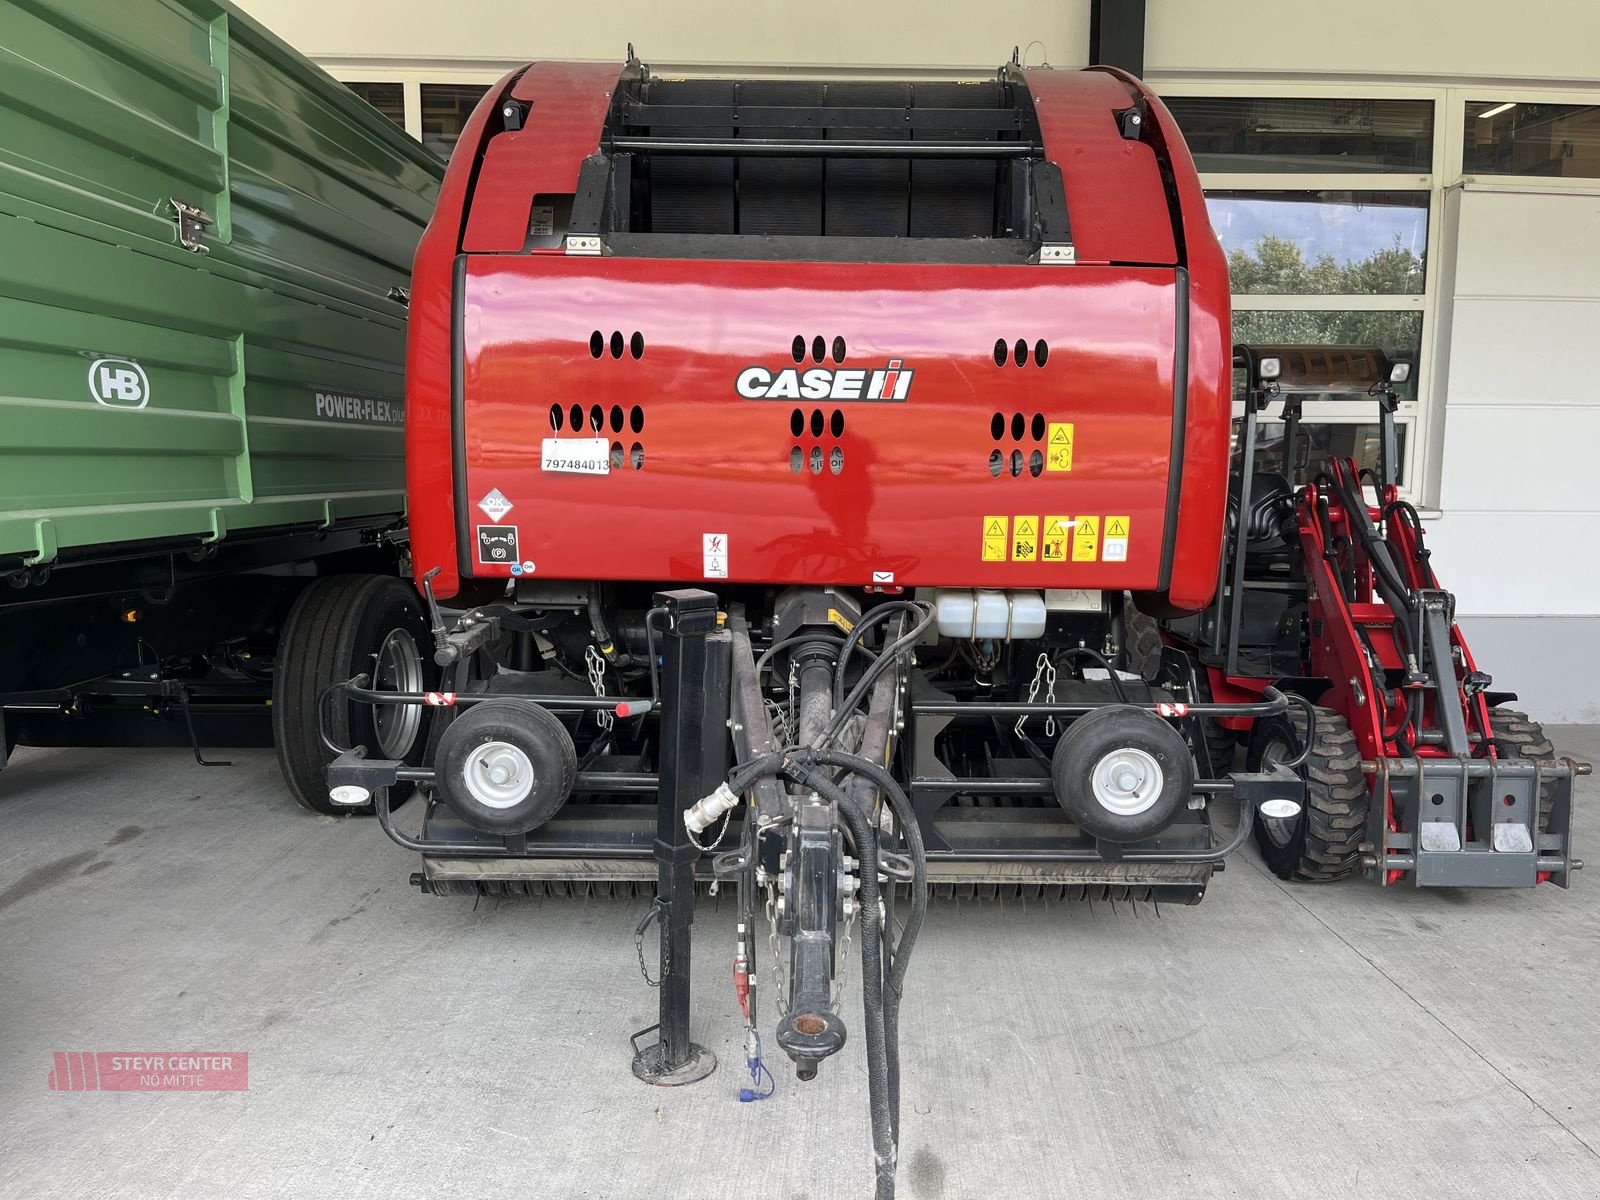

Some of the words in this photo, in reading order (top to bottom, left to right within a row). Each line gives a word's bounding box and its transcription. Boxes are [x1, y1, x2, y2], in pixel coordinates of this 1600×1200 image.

[100, 366, 142, 401] HB
[736, 366, 866, 399] CASE
[315, 392, 392, 422] POWER-FLEX
[545, 458, 610, 471] 797484013
